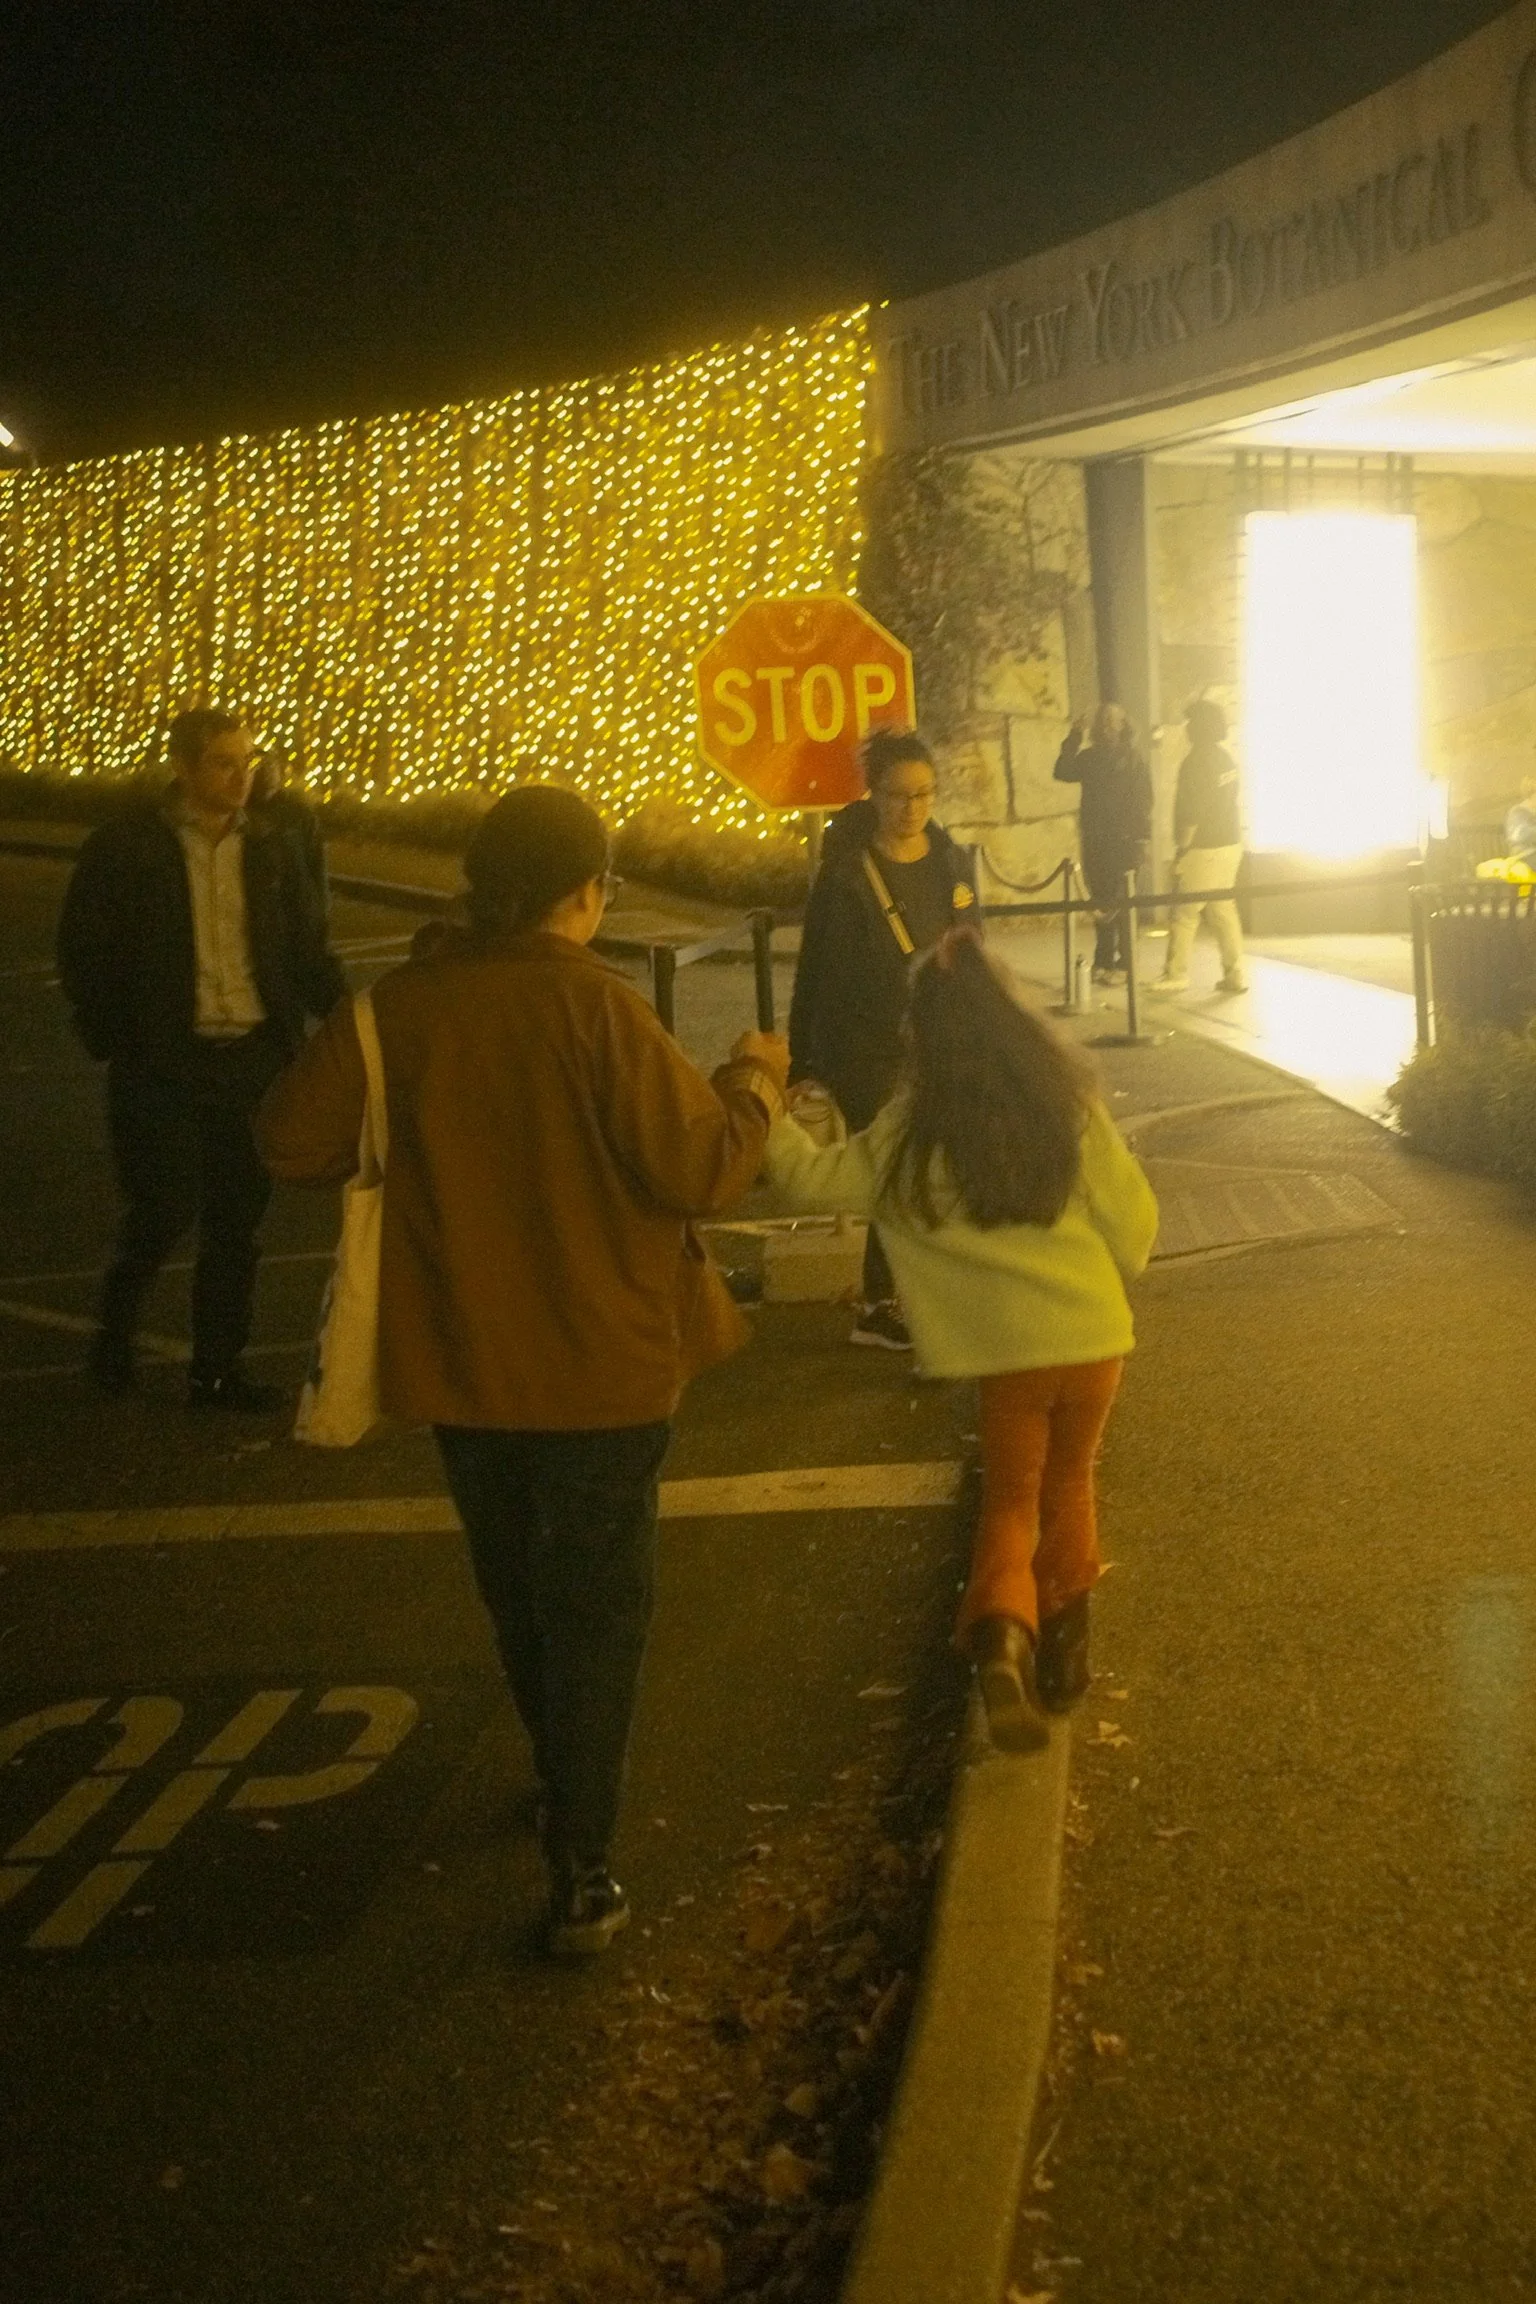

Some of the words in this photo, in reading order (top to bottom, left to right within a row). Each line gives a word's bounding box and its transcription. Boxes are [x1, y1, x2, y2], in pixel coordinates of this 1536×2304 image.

[979, 300, 1071, 398] NEW
[1078, 259, 1196, 366] YORK
[712, 663, 897, 746] STOP
